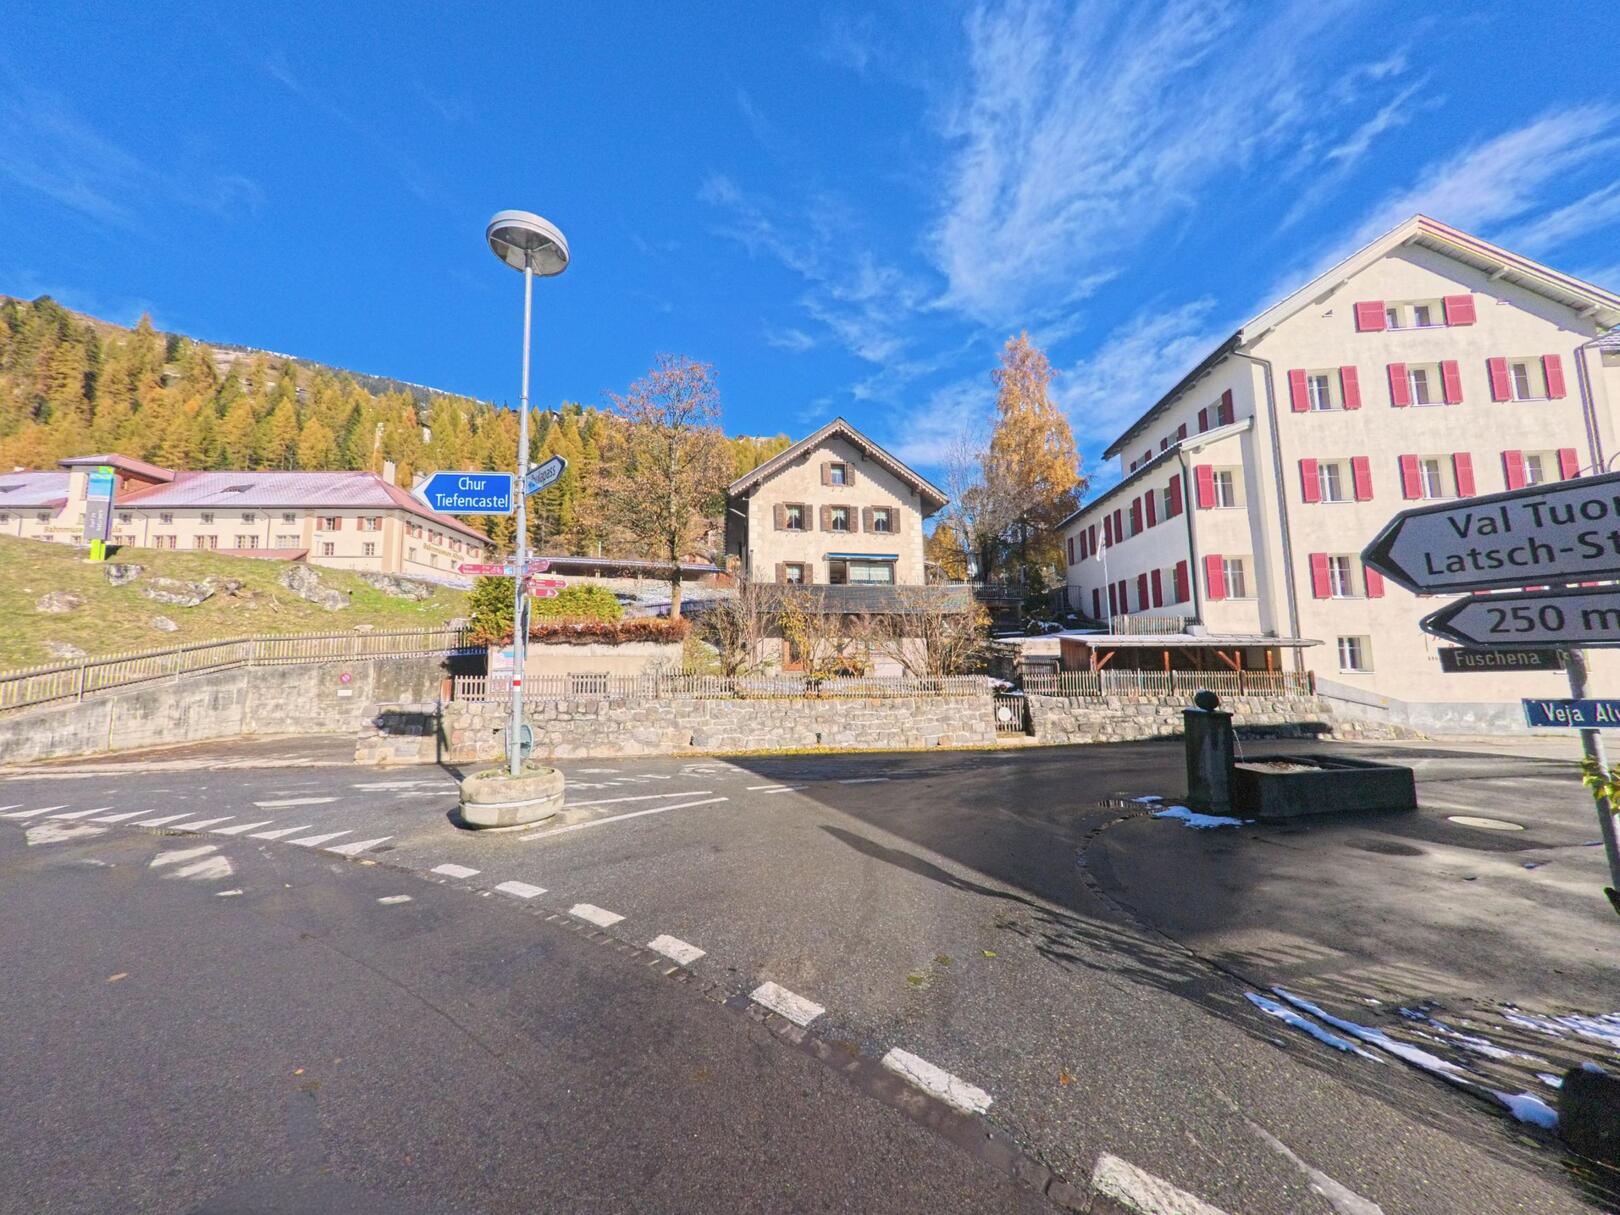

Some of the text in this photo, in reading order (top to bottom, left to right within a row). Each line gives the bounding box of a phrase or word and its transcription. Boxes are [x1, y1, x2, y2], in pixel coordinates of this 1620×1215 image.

[458, 477, 487, 491] Chur
[436, 494, 509, 508] Tiefencastel
[1447, 506, 1511, 539] Val
[1487, 605, 1565, 633] 250
[1454, 649, 1542, 667] Fuschena
[1540, 702, 1585, 727] Veja
